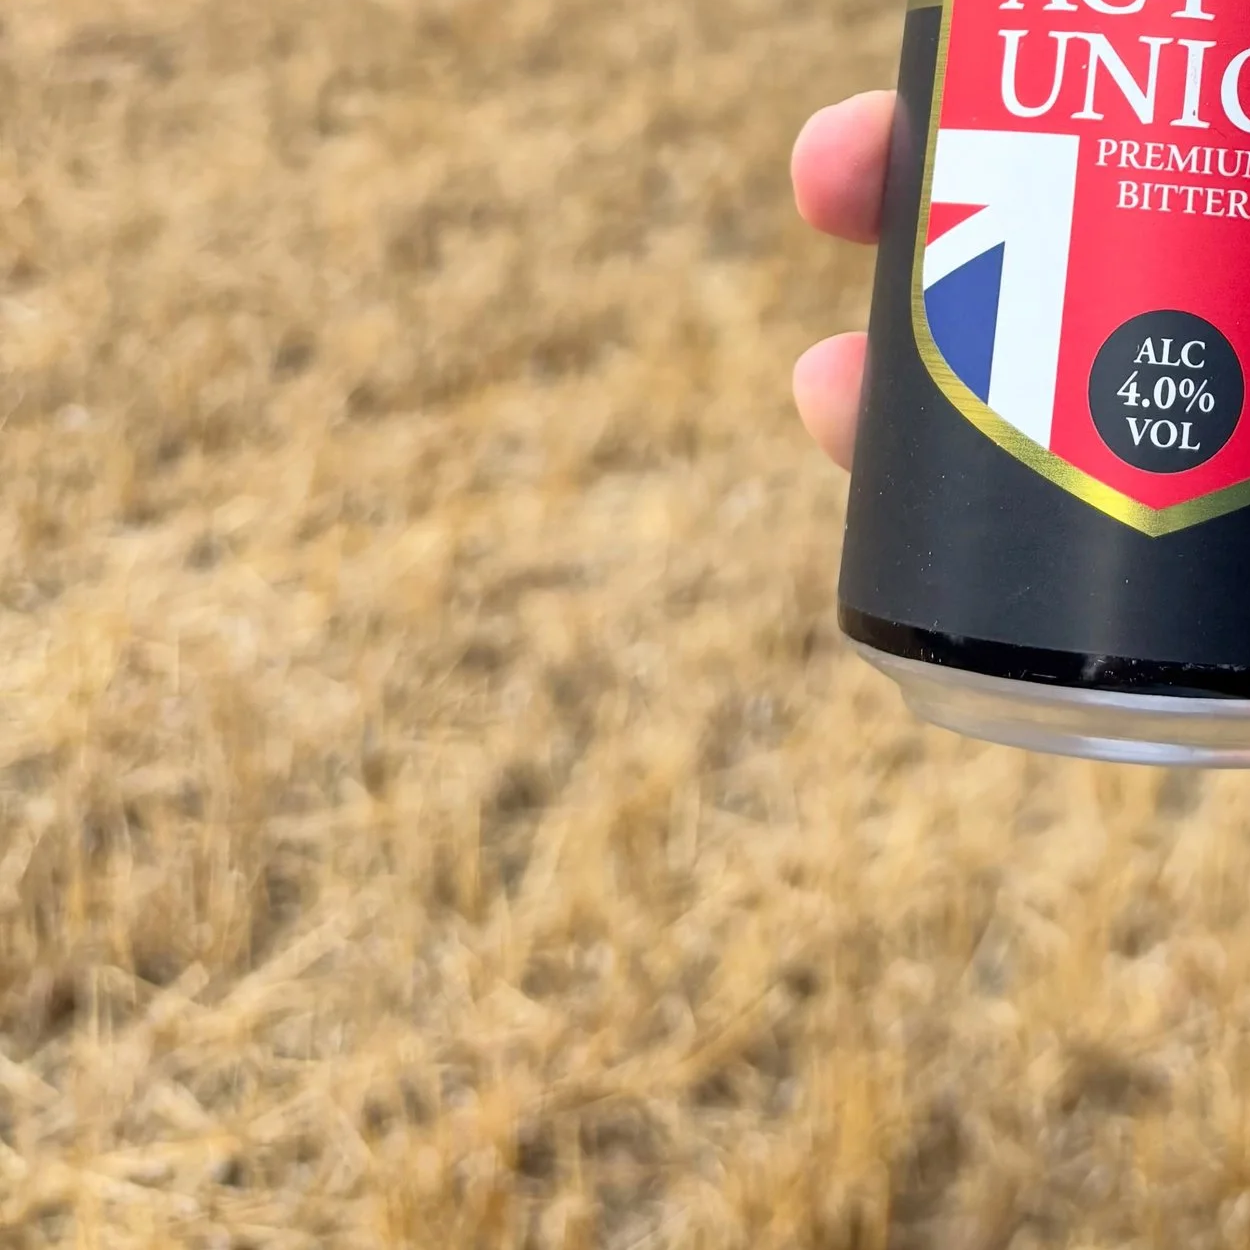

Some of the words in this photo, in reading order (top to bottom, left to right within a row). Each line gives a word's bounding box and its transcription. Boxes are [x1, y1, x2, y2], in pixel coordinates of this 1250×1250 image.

[1116, 180, 1250, 219] BITTER
[1134, 337, 1206, 369] ALC
[1116, 370, 1215, 413] 4.0%
[1125, 416, 1201, 451] VOL
